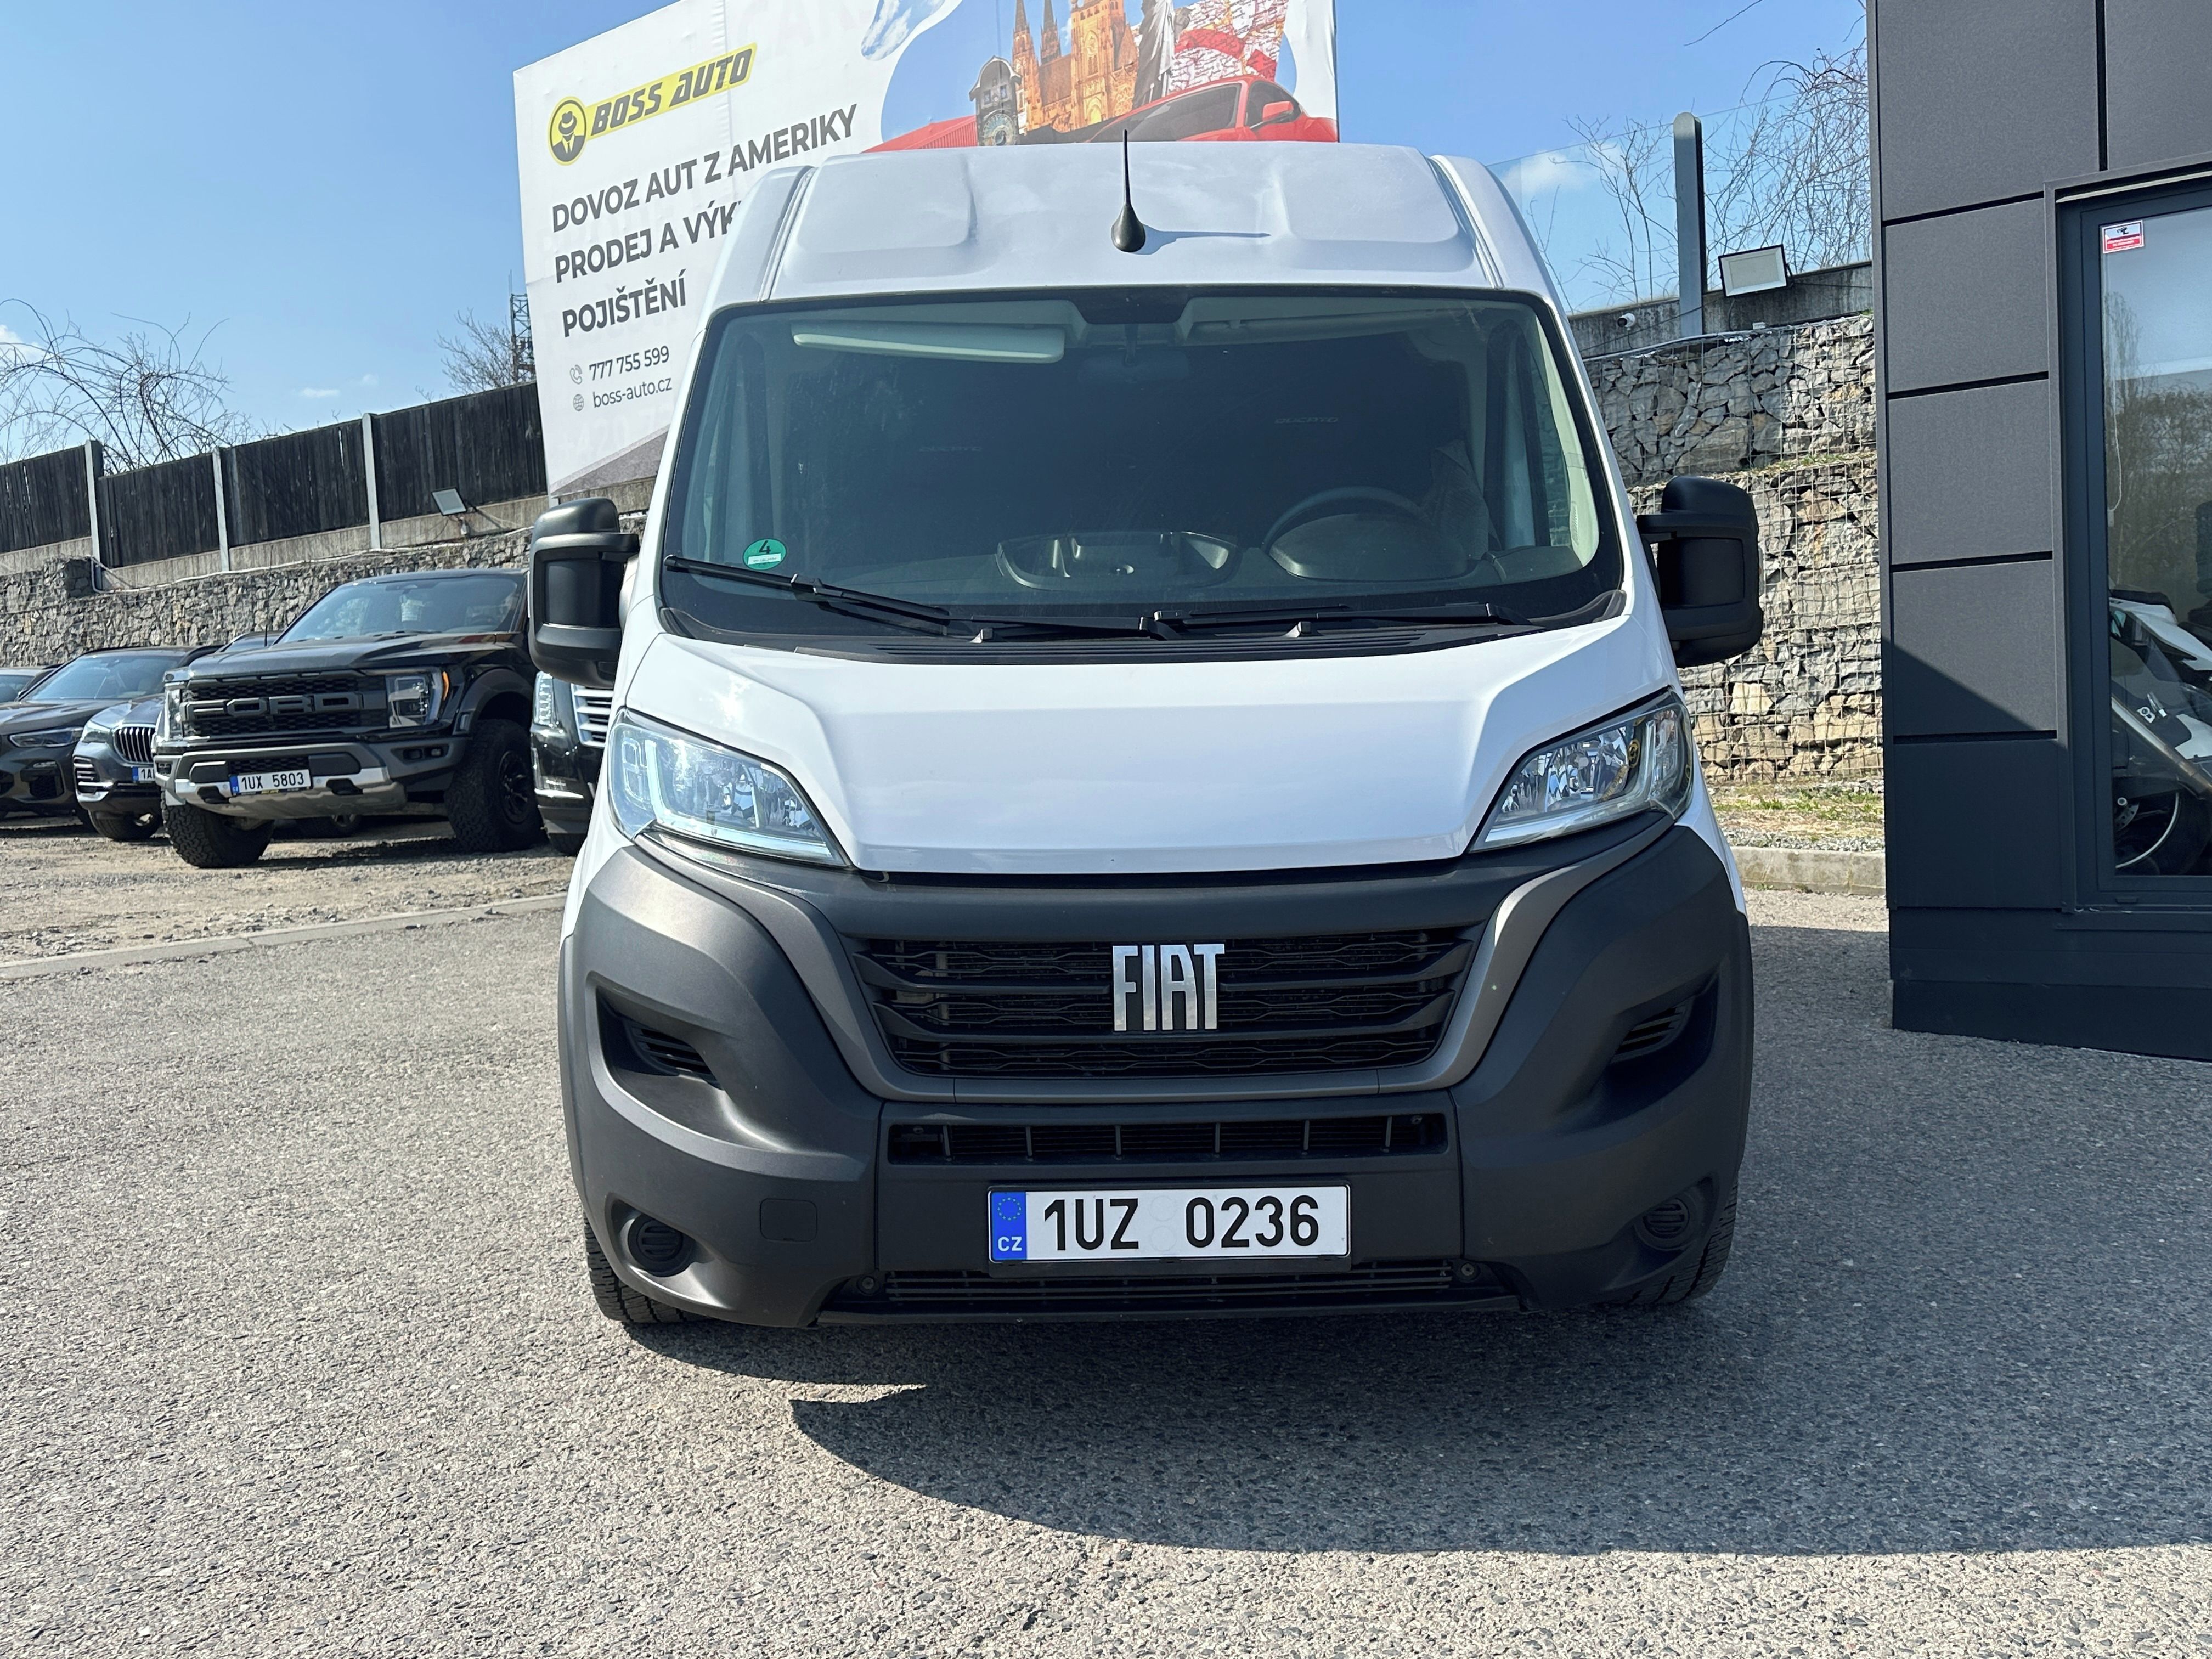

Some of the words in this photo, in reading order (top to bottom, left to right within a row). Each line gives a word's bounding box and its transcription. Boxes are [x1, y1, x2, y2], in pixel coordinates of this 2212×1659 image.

[590, 82, 663, 137] BOSS
[669, 47, 753, 108] AUTO
[552, 179, 640, 233] DOVOZ
[645, 159, 697, 204] AUT
[704, 151, 722, 185] Z
[727, 103, 857, 178] AMERIKY
[555, 228, 652, 284] PRODEJ
[659, 222, 679, 254] A
[682, 200, 742, 244] VÝK
[562, 268, 687, 338] POJIŠTĚNÍ
[589, 359, 613, 381] 777
[616, 352, 641, 374] 755
[644, 345, 669, 367] 599
[592, 377, 673, 408] boss-auto.cz
[1273, 416, 1339, 424] DUCATO
[759, 540, 771, 554] 4
[185, 691, 361, 722] FORD
[241, 775, 263, 791] 1UX
[272, 772, 304, 788] 5803
[1113, 943, 1226, 1031] FIAT
[997, 1236, 1023, 1252] CZ
[1044, 1198, 1139, 1251] 1UZ
[1185, 1194, 1319, 1249] 0236
